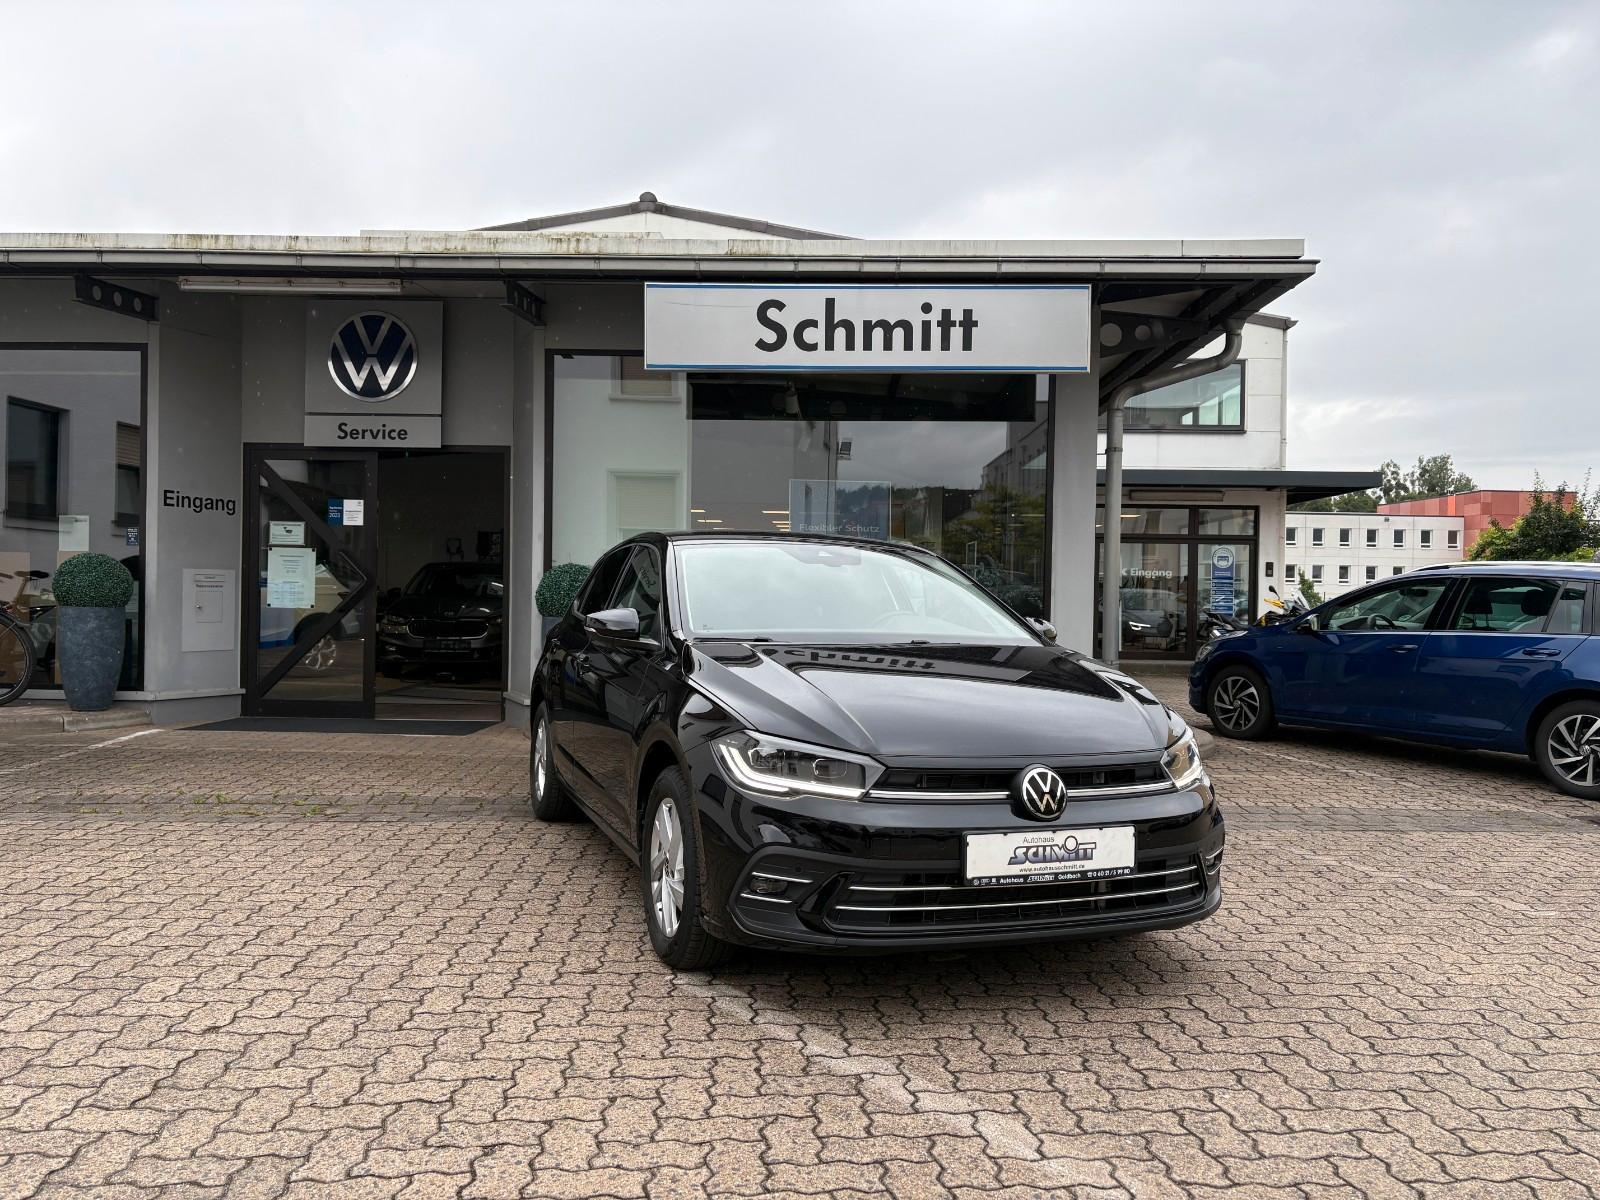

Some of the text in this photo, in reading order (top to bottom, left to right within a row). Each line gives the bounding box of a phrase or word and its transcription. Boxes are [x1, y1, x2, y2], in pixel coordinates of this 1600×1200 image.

[754, 298, 979, 352] Schmitt
[337, 422, 408, 440] Service
[163, 489, 236, 516] Eingang
[847, 523, 880, 533] Schutz
[1130, 567, 1173, 579] Eingang
[1022, 836, 1055, 845] Autohaus
[1058, 872, 1082, 880] Goldbach
